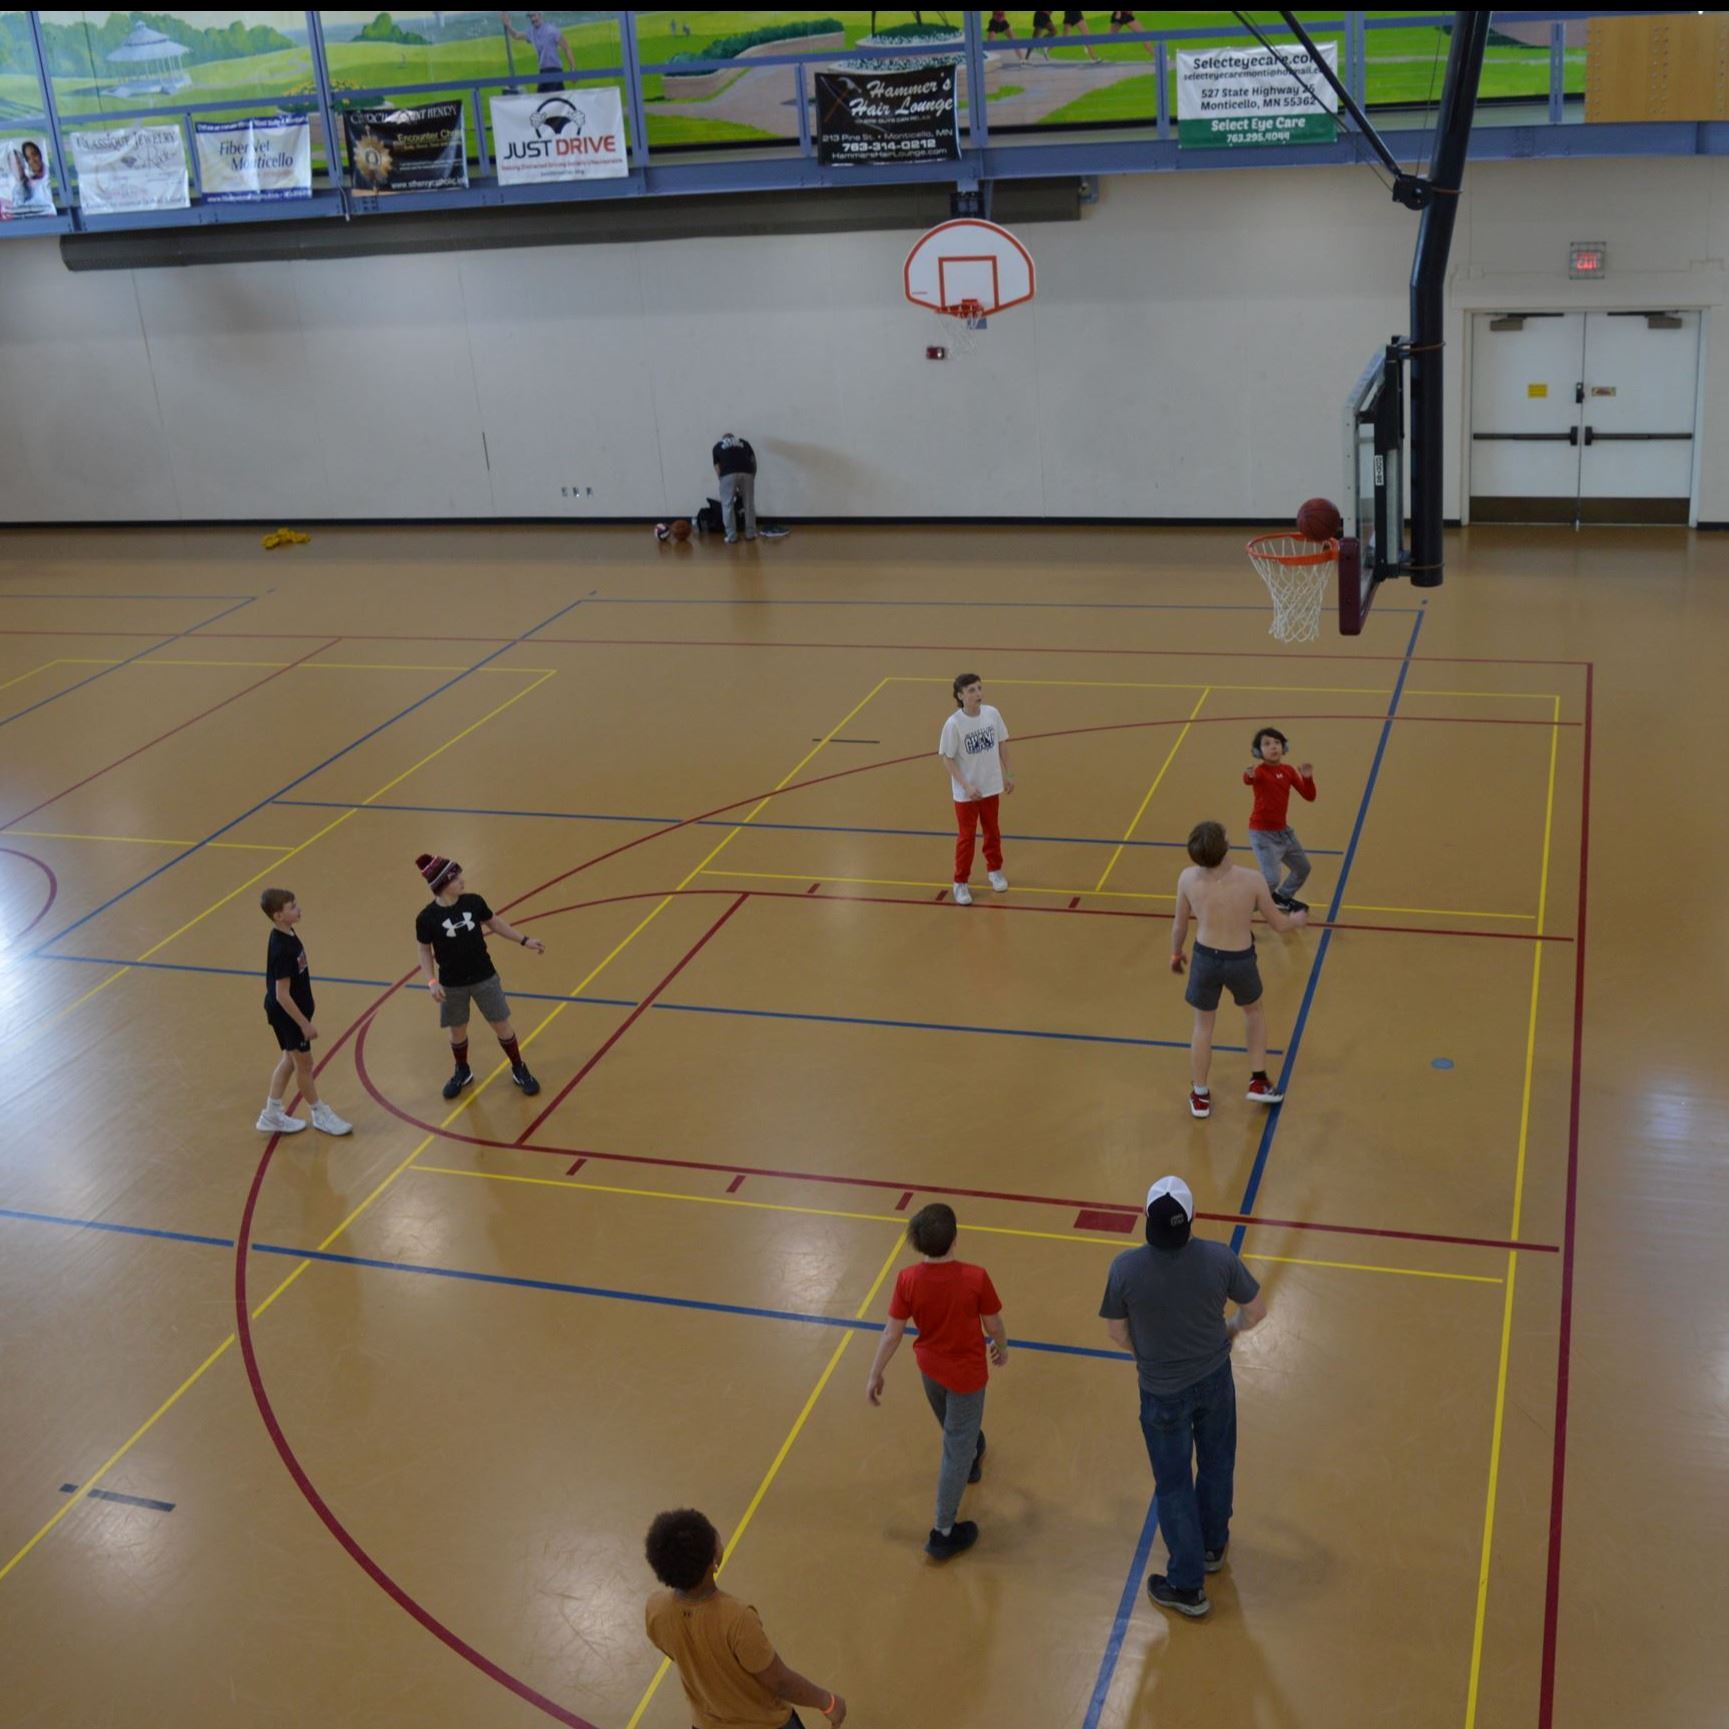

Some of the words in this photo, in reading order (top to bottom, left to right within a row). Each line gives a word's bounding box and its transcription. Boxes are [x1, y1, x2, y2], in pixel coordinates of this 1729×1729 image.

[867, 72, 952, 98] Hammer's
[1201, 88, 1219, 98] 527
[1222, 87, 1249, 97] State
[1252, 85, 1299, 98] Highway
[849, 97, 890, 117] Hair
[895, 96, 953, 118] Lounge
[1201, 100, 1260, 111] Monticello,
[1263, 98, 1281, 108] MN
[1283, 96, 1316, 107] 55362
[1211, 118, 1248, 131] Select
[1251, 118, 1269, 132] Eye
[1276, 117, 1306, 128] Care
[841, 133, 861, 142] Pine
[936, 128, 953, 137] MN
[504, 139, 552, 160] JUST
[556, 135, 616, 156] DRIVE
[232, 151, 294, 171] Moticello
